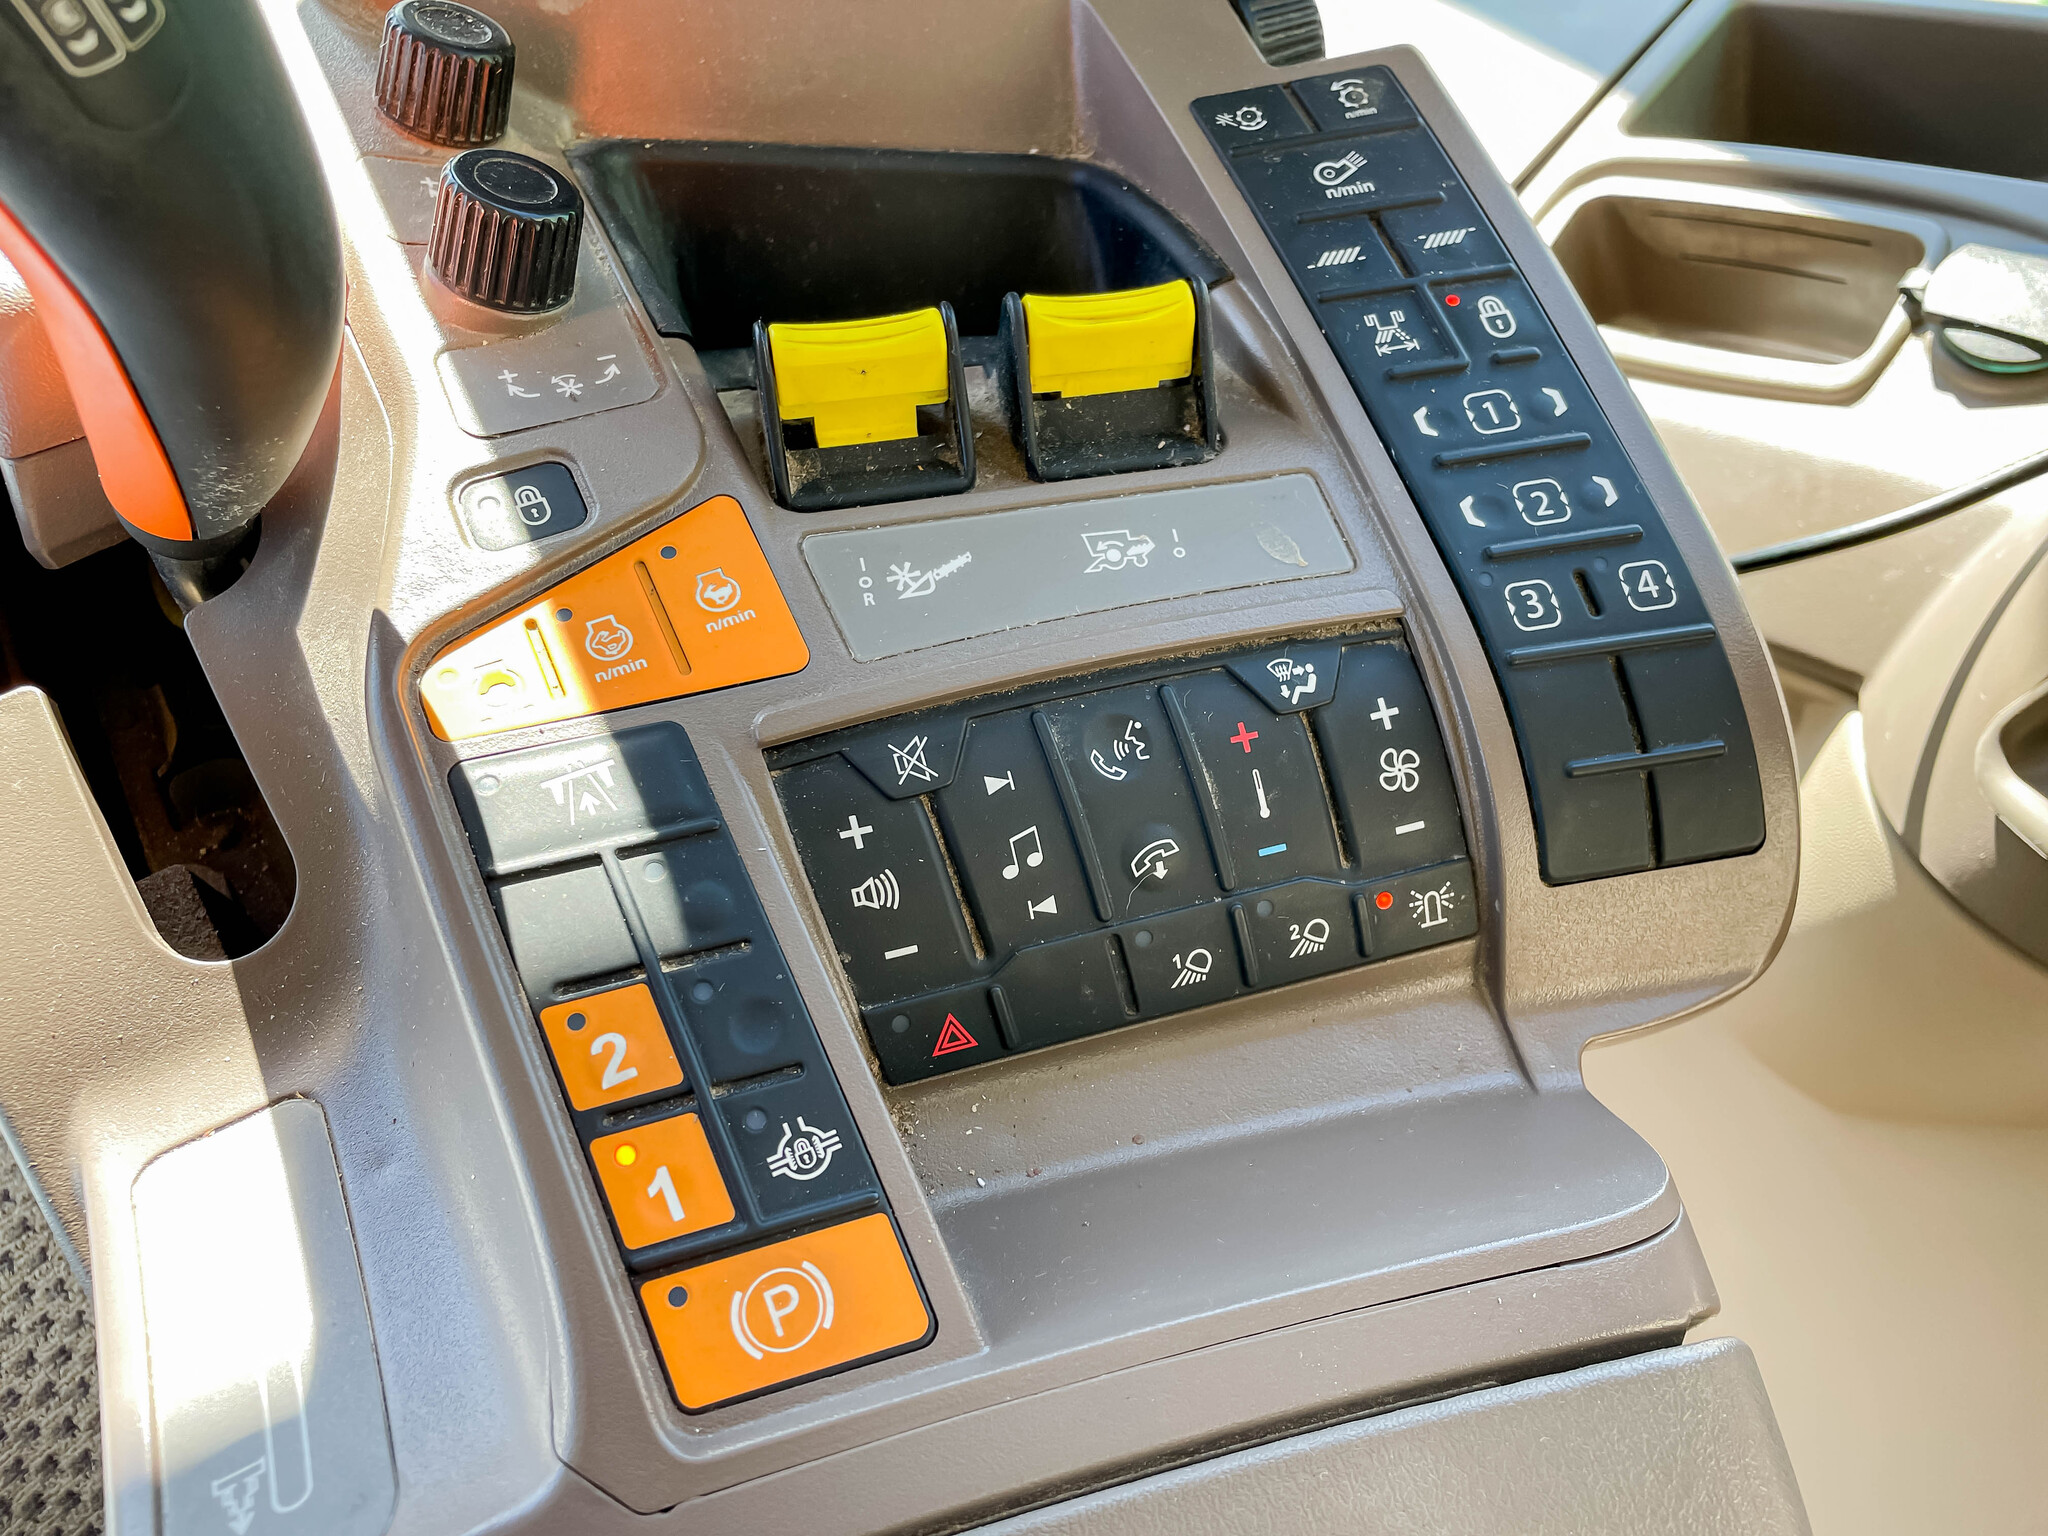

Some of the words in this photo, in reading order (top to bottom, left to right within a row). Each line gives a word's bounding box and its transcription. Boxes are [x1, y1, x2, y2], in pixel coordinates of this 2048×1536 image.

[1325, 181, 1376, 199] n/min
[1481, 401, 1500, 424] 1
[1529, 490, 1555, 517] 2
[1637, 569, 1660, 599] 4
[863, 592, 876, 606] R
[1520, 590, 1545, 620] 3
[705, 606, 756, 634] n/min
[594, 656, 648, 683] n/min
[1289, 924, 1301, 941] 2
[1172, 953, 1182, 969] 1
[590, 1032, 638, 1091] 2
[647, 1165, 685, 1222] 1
[763, 1283, 800, 1338] P
